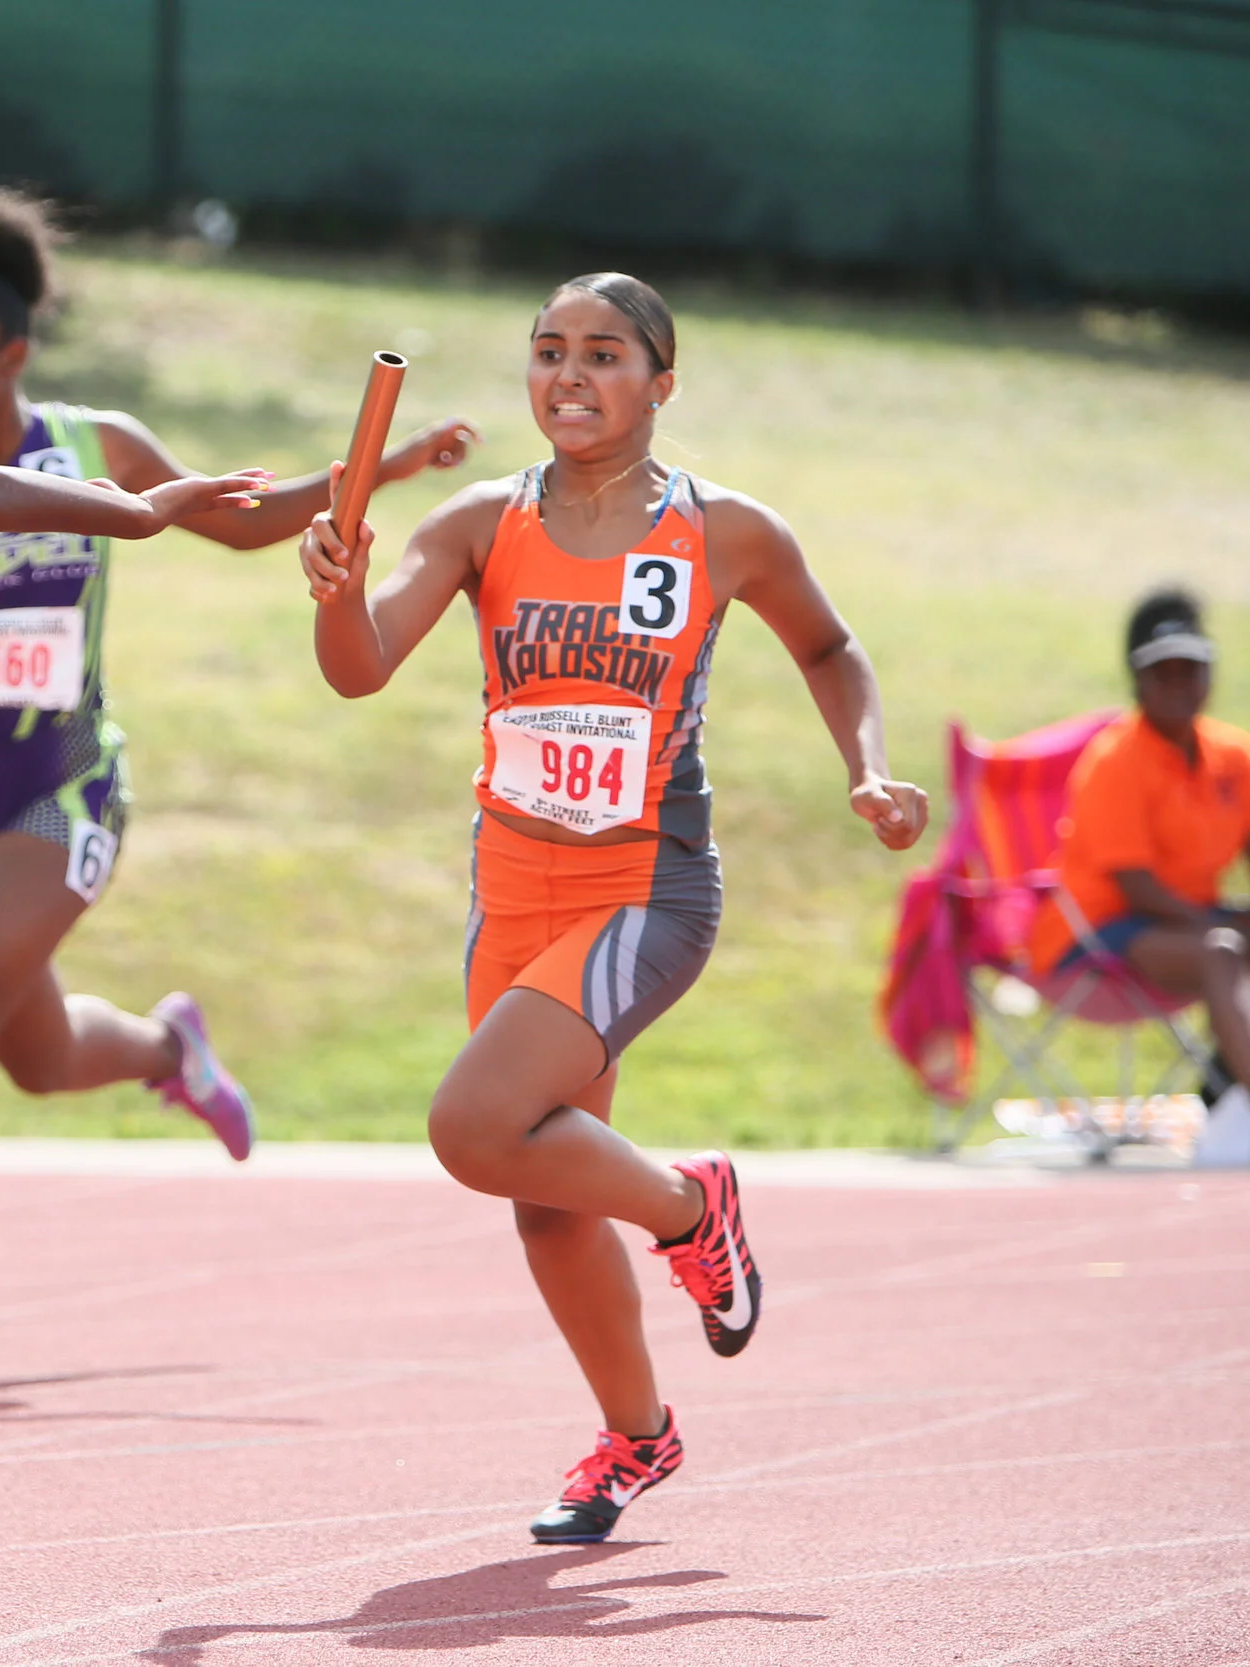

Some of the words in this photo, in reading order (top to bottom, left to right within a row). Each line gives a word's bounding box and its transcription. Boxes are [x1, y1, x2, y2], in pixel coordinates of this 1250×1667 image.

[629, 560, 676, 629] 3
[516, 601, 650, 646] TRAC
[495, 630, 669, 704] XPLOSION
[539, 710, 580, 722] RUSSELL
[598, 714, 632, 727] BLUNT
[566, 724, 637, 740] INVITATIONAL
[542, 740, 624, 806] 984
[80, 833, 103, 889] 6
